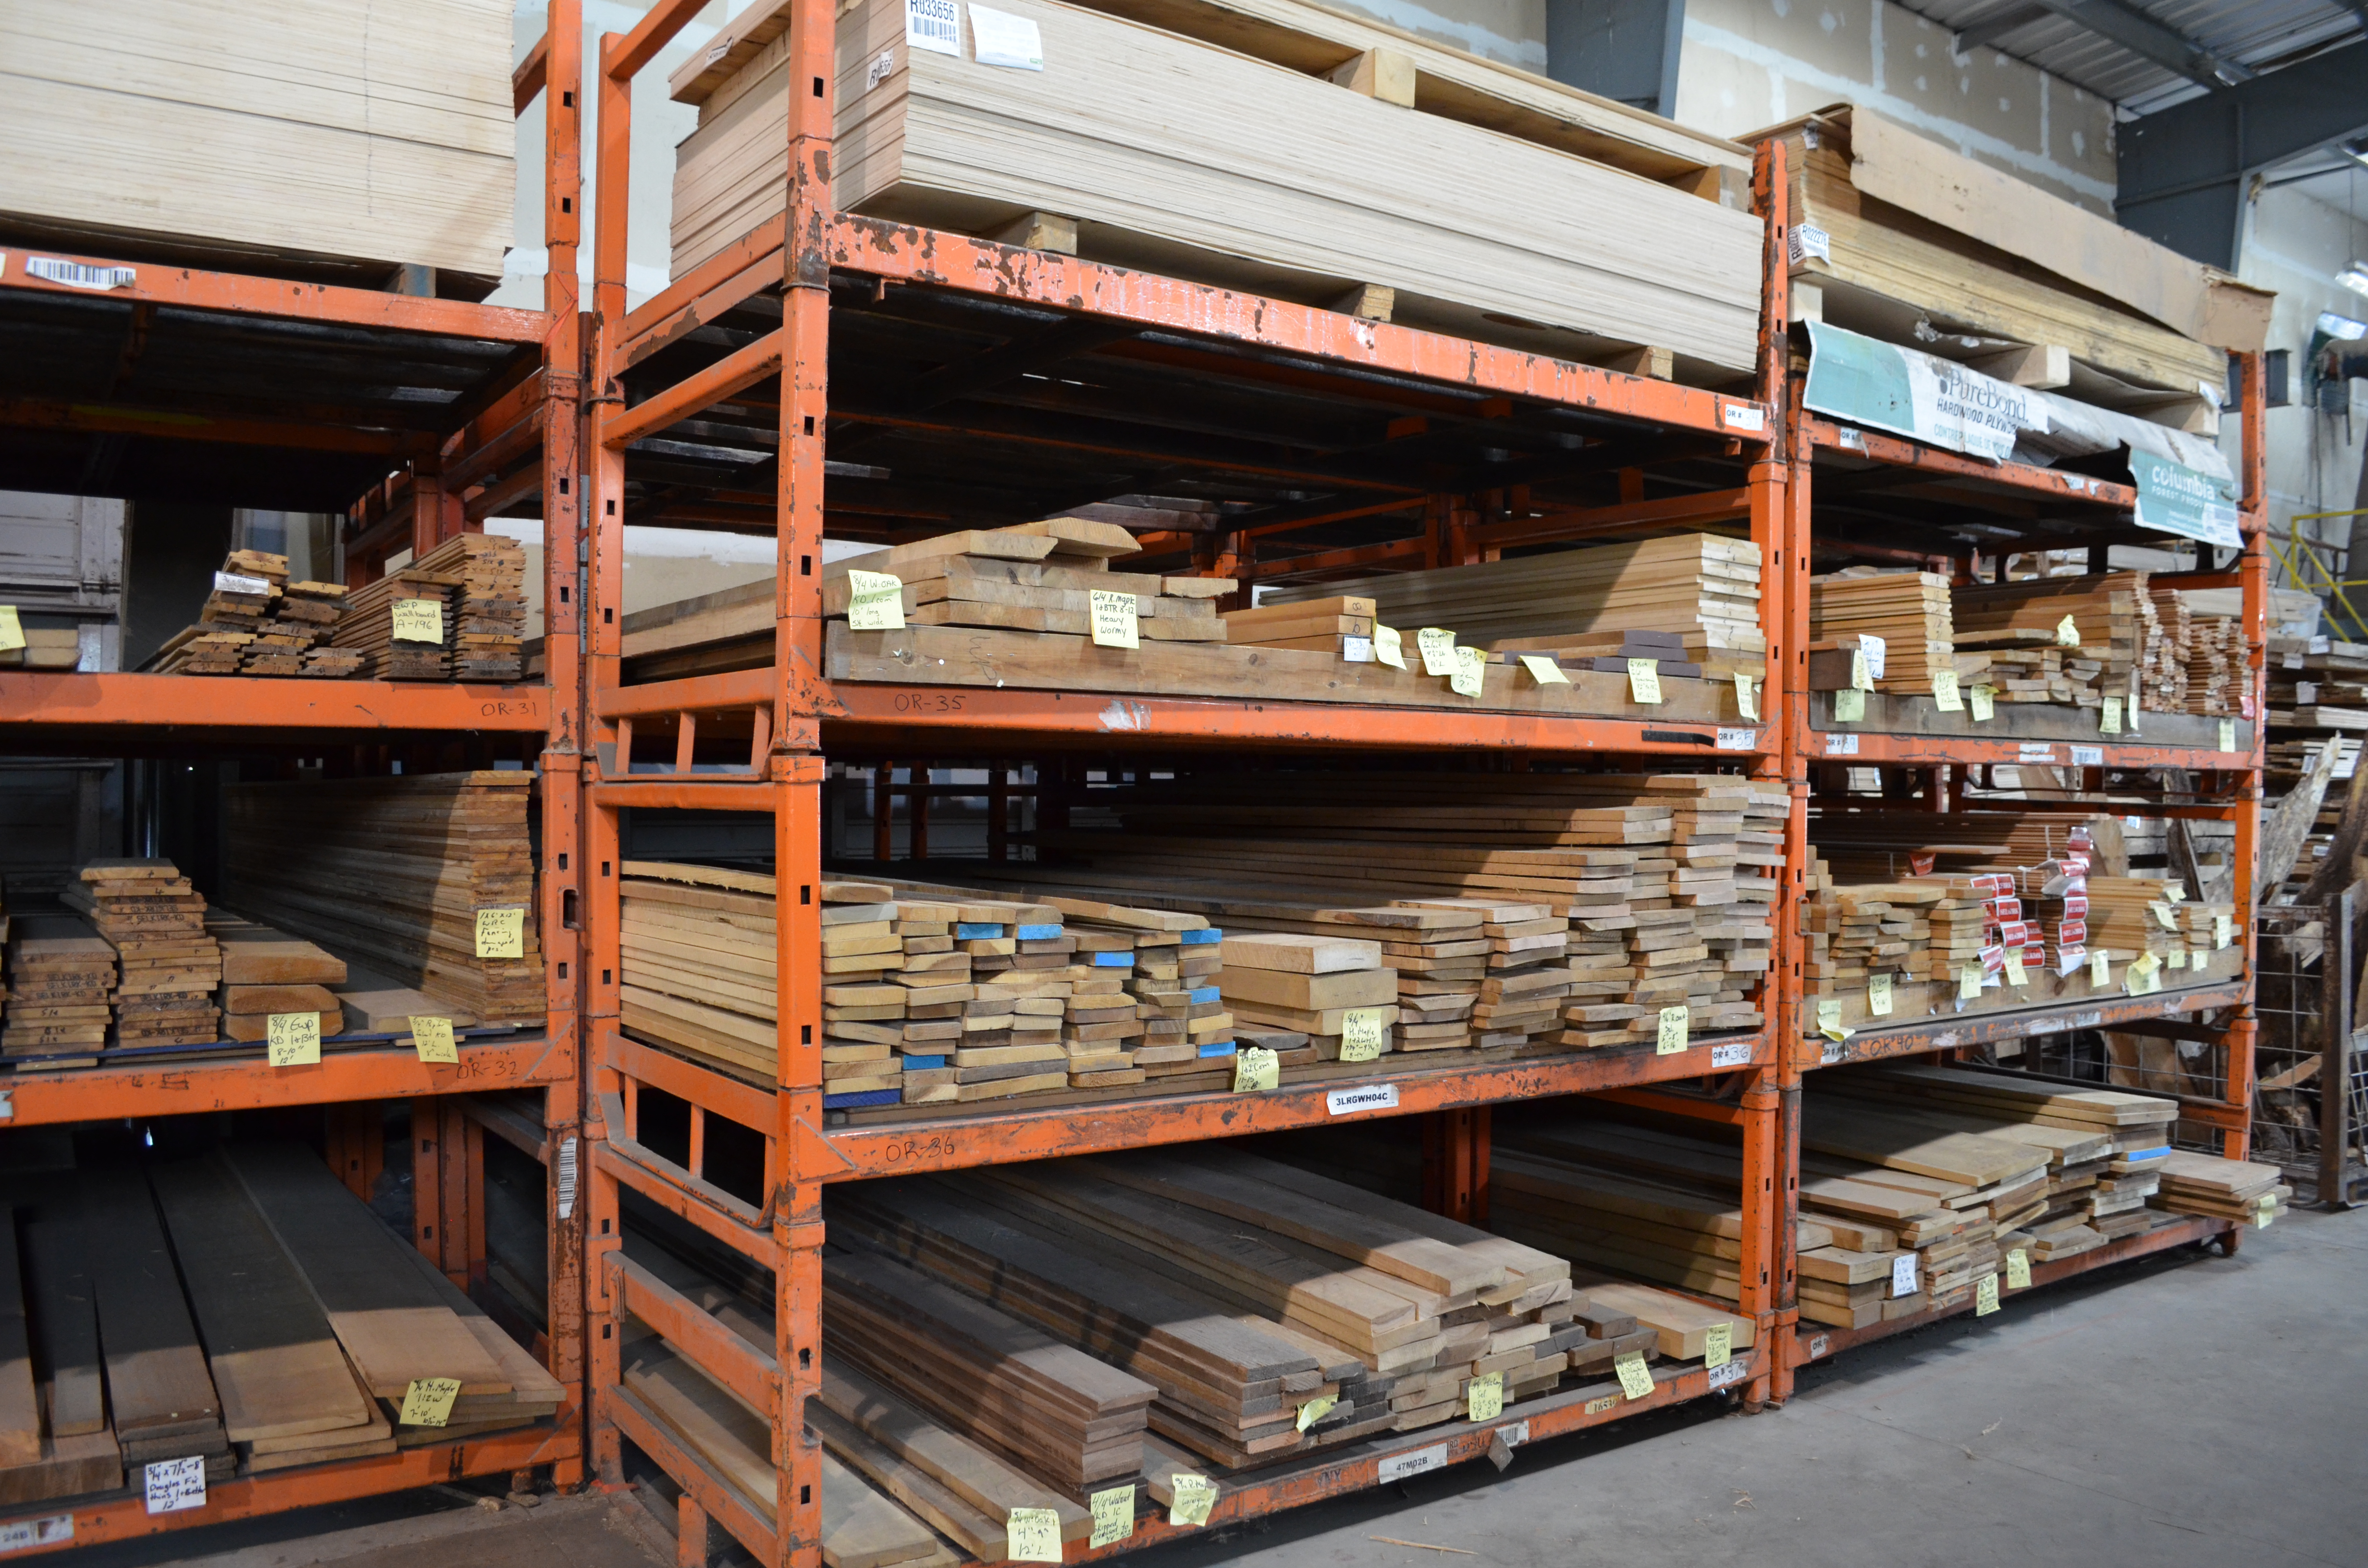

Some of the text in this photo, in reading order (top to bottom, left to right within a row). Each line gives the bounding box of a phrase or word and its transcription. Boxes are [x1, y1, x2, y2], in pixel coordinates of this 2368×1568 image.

[911, 0, 954, 21] R033656
[1727, 410, 1736, 418] OR
[1937, 398, 1983, 424] HARDWOOD
[2152, 465, 2215, 501] columbia
[867, 607, 879, 617] long
[867, 617, 884, 626] wide
[1100, 614, 1124, 626] Heavy
[1100, 626, 1127, 638] Wormy
[481, 702, 537, 716] OR-31
[895, 694, 966, 711] OR-35
[271, 1016, 287, 1034] 8/4
[270, 1035, 284, 1047] KD
[456, 1061, 518, 1079] OR-32
[1336, 1092, 1388, 1106] 3LRGWH04C
[886, 1136, 955, 1162] OR-36
[1710, 1371, 1720, 1381] OR
[1396, 1456, 1428, 1471] 47M02B
[1109, 1491, 1132, 1506] Walnut
